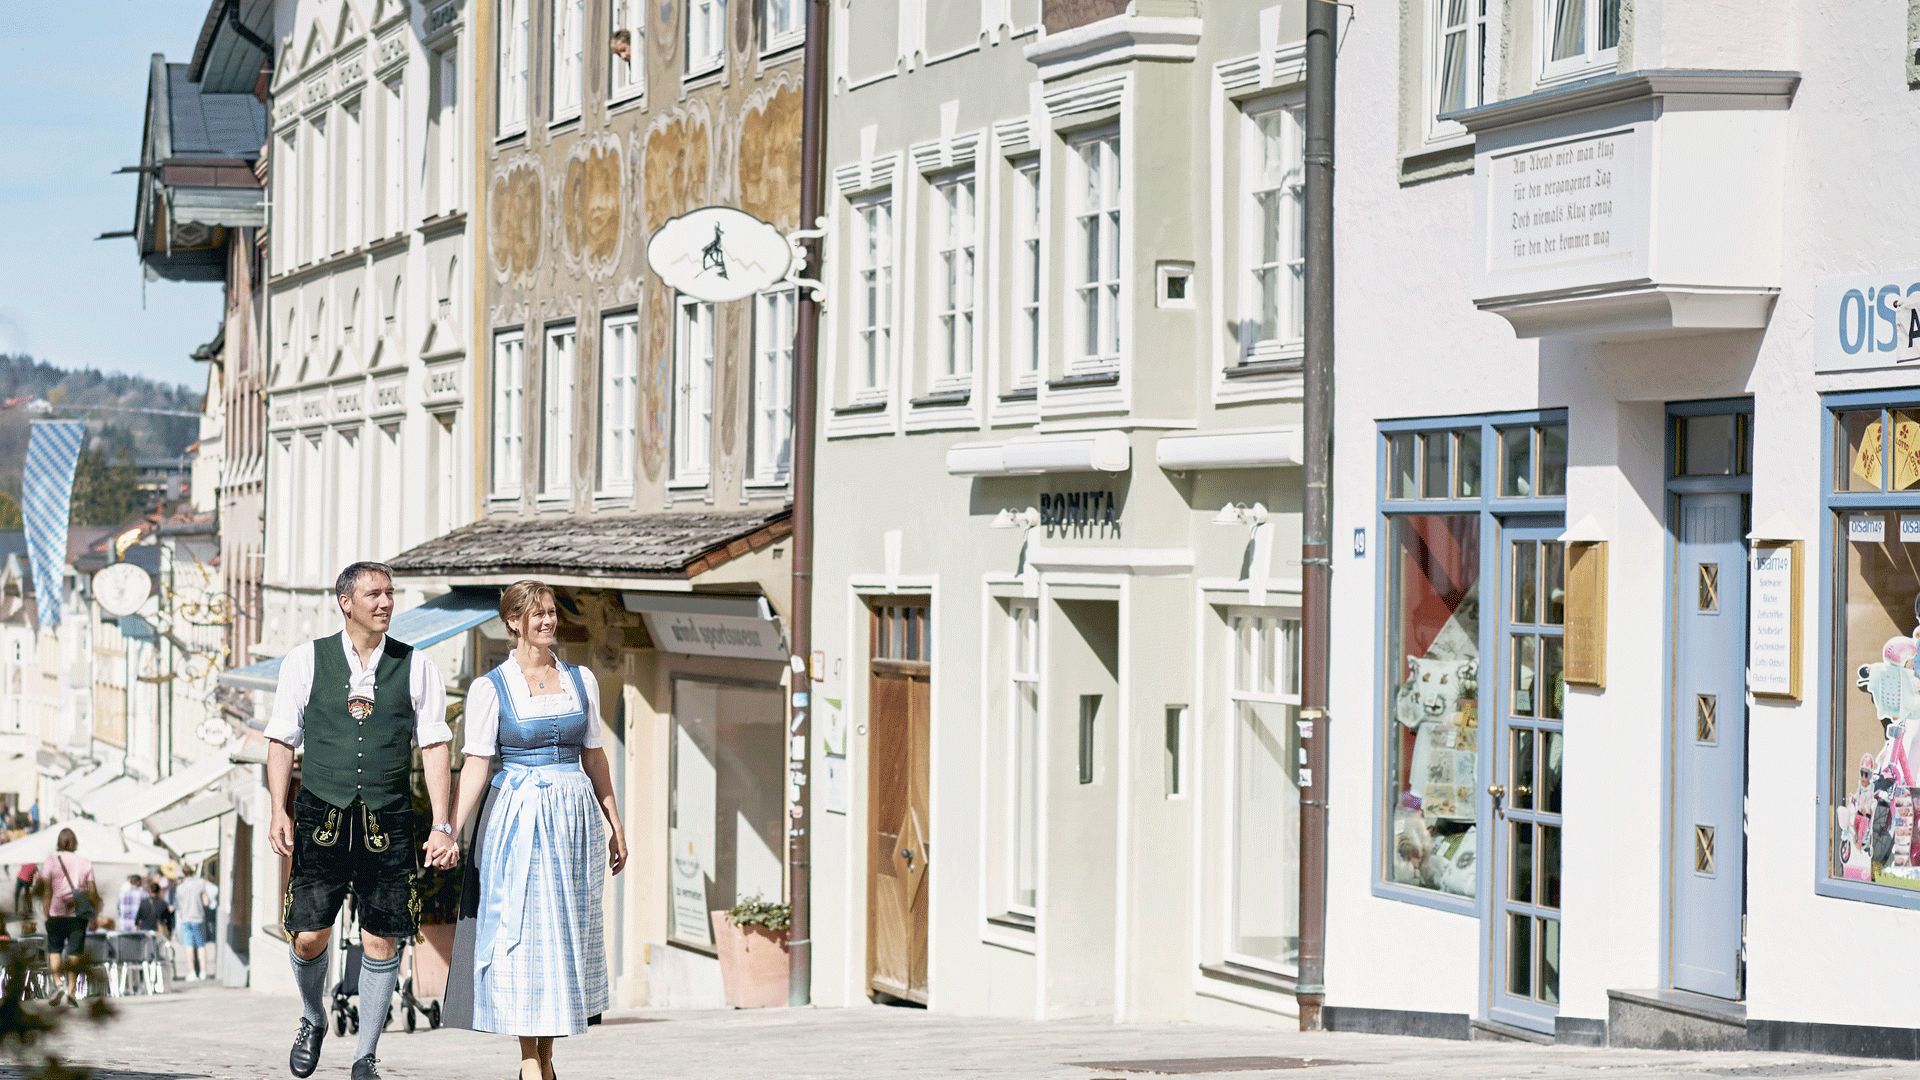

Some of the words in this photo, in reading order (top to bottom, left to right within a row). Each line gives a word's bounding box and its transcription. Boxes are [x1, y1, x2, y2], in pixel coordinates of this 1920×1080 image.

[1513, 157, 1526, 174] Am
[1529, 152, 1553, 172] Abend
[1556, 147, 1573, 167] wird
[1577, 147, 1594, 162] man
[1513, 182, 1526, 201] für
[1528, 183, 1541, 199] den
[1544, 175, 1591, 198] vergangenen
[1595, 168, 1612, 189] Tag
[1511, 211, 1530, 230] Doch
[1533, 205, 1563, 226] niemals
[1589, 200, 1613, 221] genug
[1513, 238, 1526, 258] für
[1528, 239, 1541, 256] den
[1544, 237, 1556, 253] der
[1559, 233, 1590, 251] kommen
[1593, 230, 1610, 248] mag
[1040, 490, 1115, 526] BONITA
